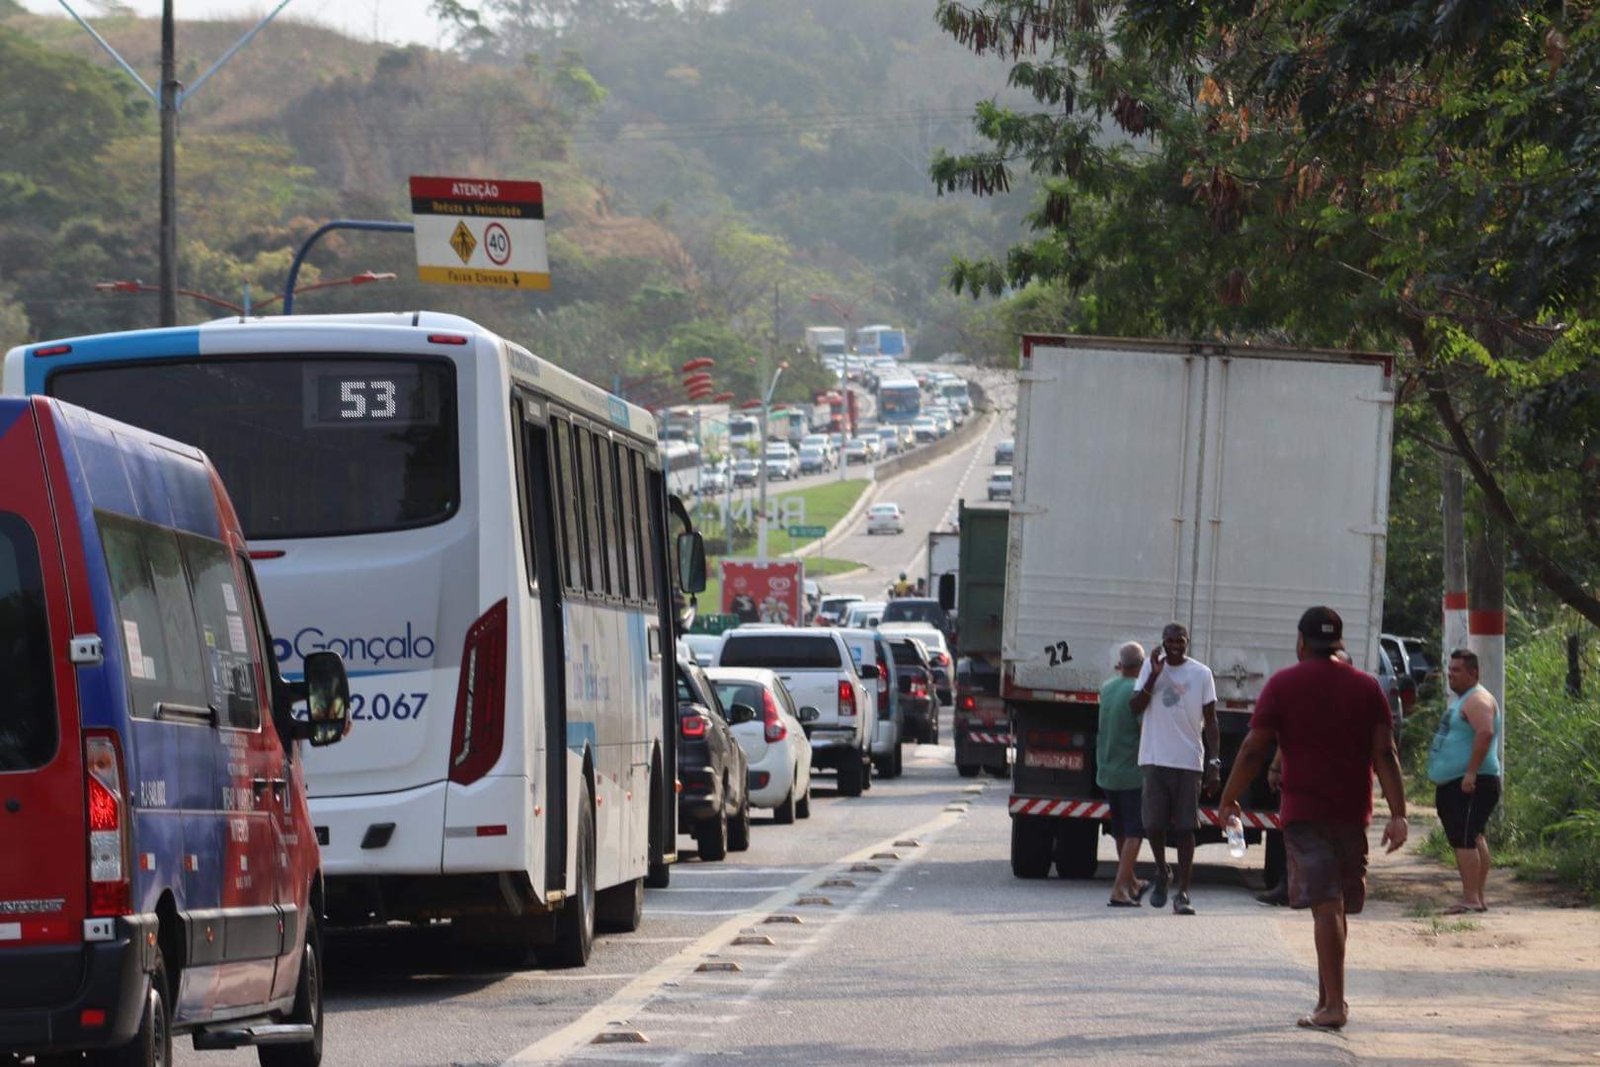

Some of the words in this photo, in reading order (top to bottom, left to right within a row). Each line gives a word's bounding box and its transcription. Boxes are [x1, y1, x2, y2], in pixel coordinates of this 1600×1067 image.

[452, 182, 499, 199] ATENÇÃO
[490, 233, 506, 252] 40
[341, 381, 396, 417] 53
[1044, 640, 1073, 667] 22
